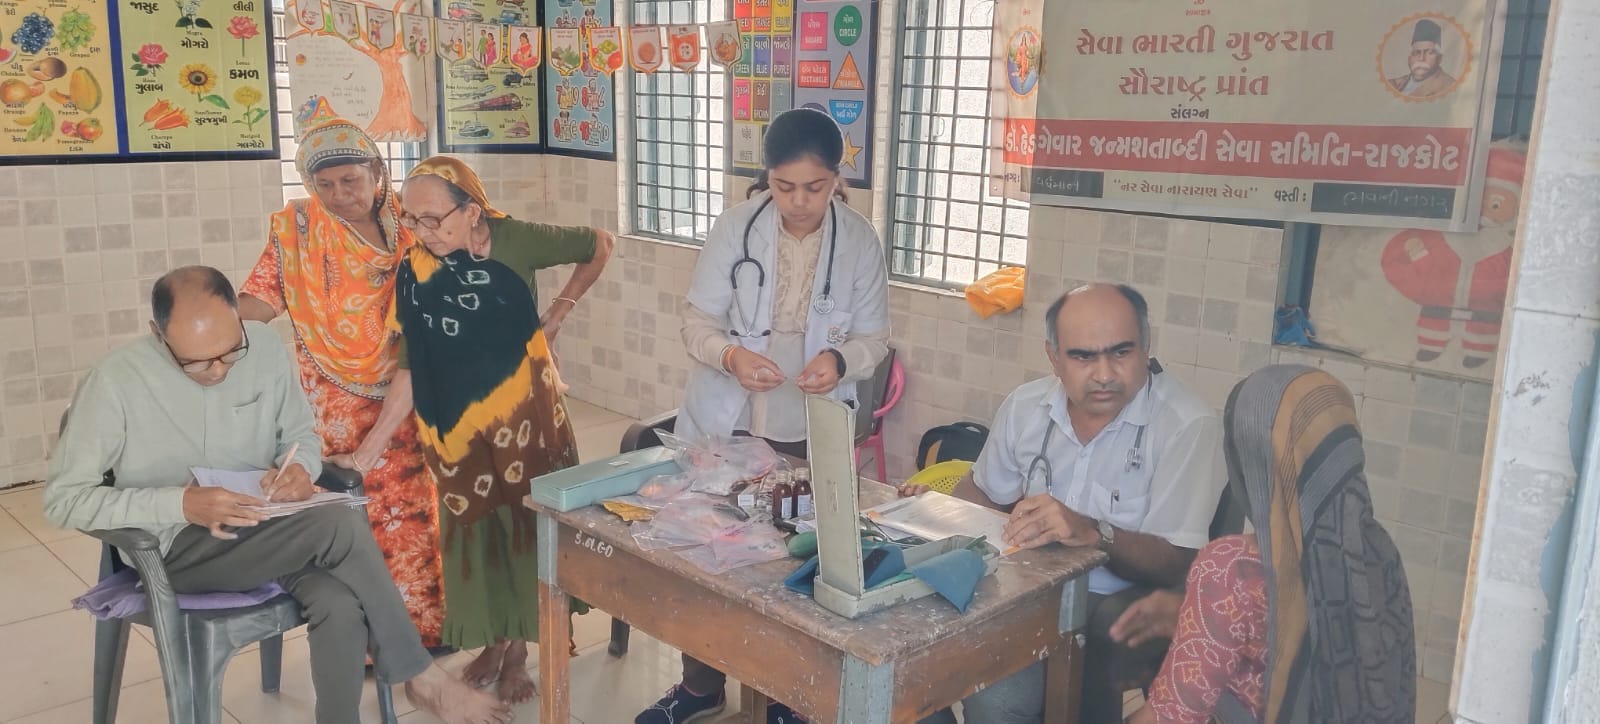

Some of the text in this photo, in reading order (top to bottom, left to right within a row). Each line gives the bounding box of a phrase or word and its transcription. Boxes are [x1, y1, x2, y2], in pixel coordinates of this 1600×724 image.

[232, 0, 254, 12] લીલી
[839, 28, 857, 37] CIRCLE
[180, 36, 209, 49] મોગરો
[1076, 24, 1335, 61] સેવા ભારતી ગુજરાત
[229, 69, 260, 80] કમળ
[756, 64, 768, 74] BLUE
[773, 64, 790, 74] PURPLE
[135, 83, 164, 95] ગુલાબ
[1119, 66, 1269, 102] સૌરાષ્ટ્ર પ્રાંત
[1170, 104, 1210, 120] સંલગ્ન
[1020, 125, 1083, 157] હેડગેવાર
[1088, 129, 1208, 161] જન્મશતાબ્દી
[1215, 129, 1261, 164] સેવા
[1270, 131, 1459, 171] સમિતિ-રાજકોટ
[1139, 180, 1163, 195] સેવા
[1166, 185, 1217, 198] નારાયણ
